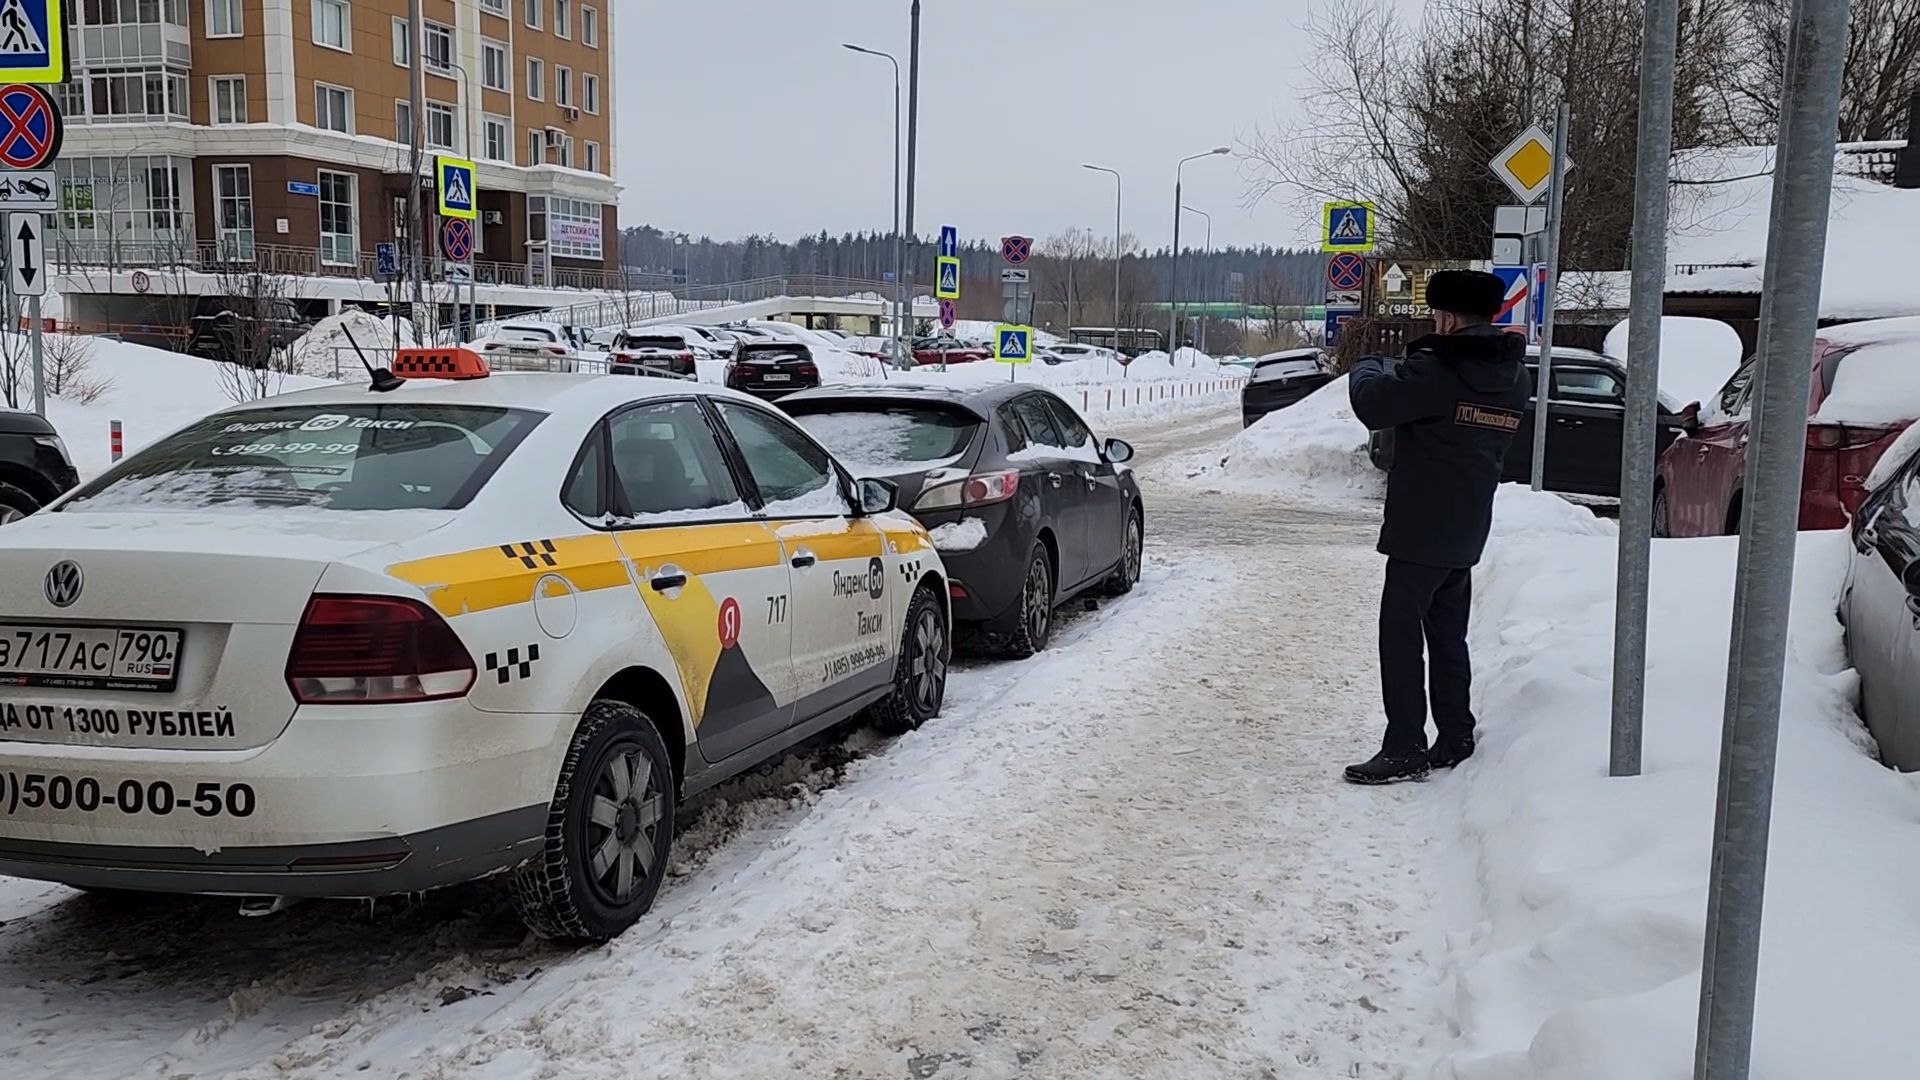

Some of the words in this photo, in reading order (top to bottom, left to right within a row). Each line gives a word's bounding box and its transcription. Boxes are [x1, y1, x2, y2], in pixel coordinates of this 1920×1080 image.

[588, 227, 600, 239] САД
[1379, 304, 1386, 314] 8
[1389, 304, 1420, 316] (985)
[347, 417, 414, 430] Такси
[221, 442, 359, 456] 999-99-99
[833, 570, 868, 599] Яндекс
[767, 594, 787, 625] 717
[724, 606, 735, 641] Я
[857, 611, 883, 637] Такси
[127, 663, 151, 674] RUS
[830, 655, 850, 681] (495)
[26, 705, 54, 730] ОТ
[63, 708, 119, 734] 1300
[127, 705, 235, 737] РУБЛЕЙ
[0, 772, 256, 818] )500-00-50
